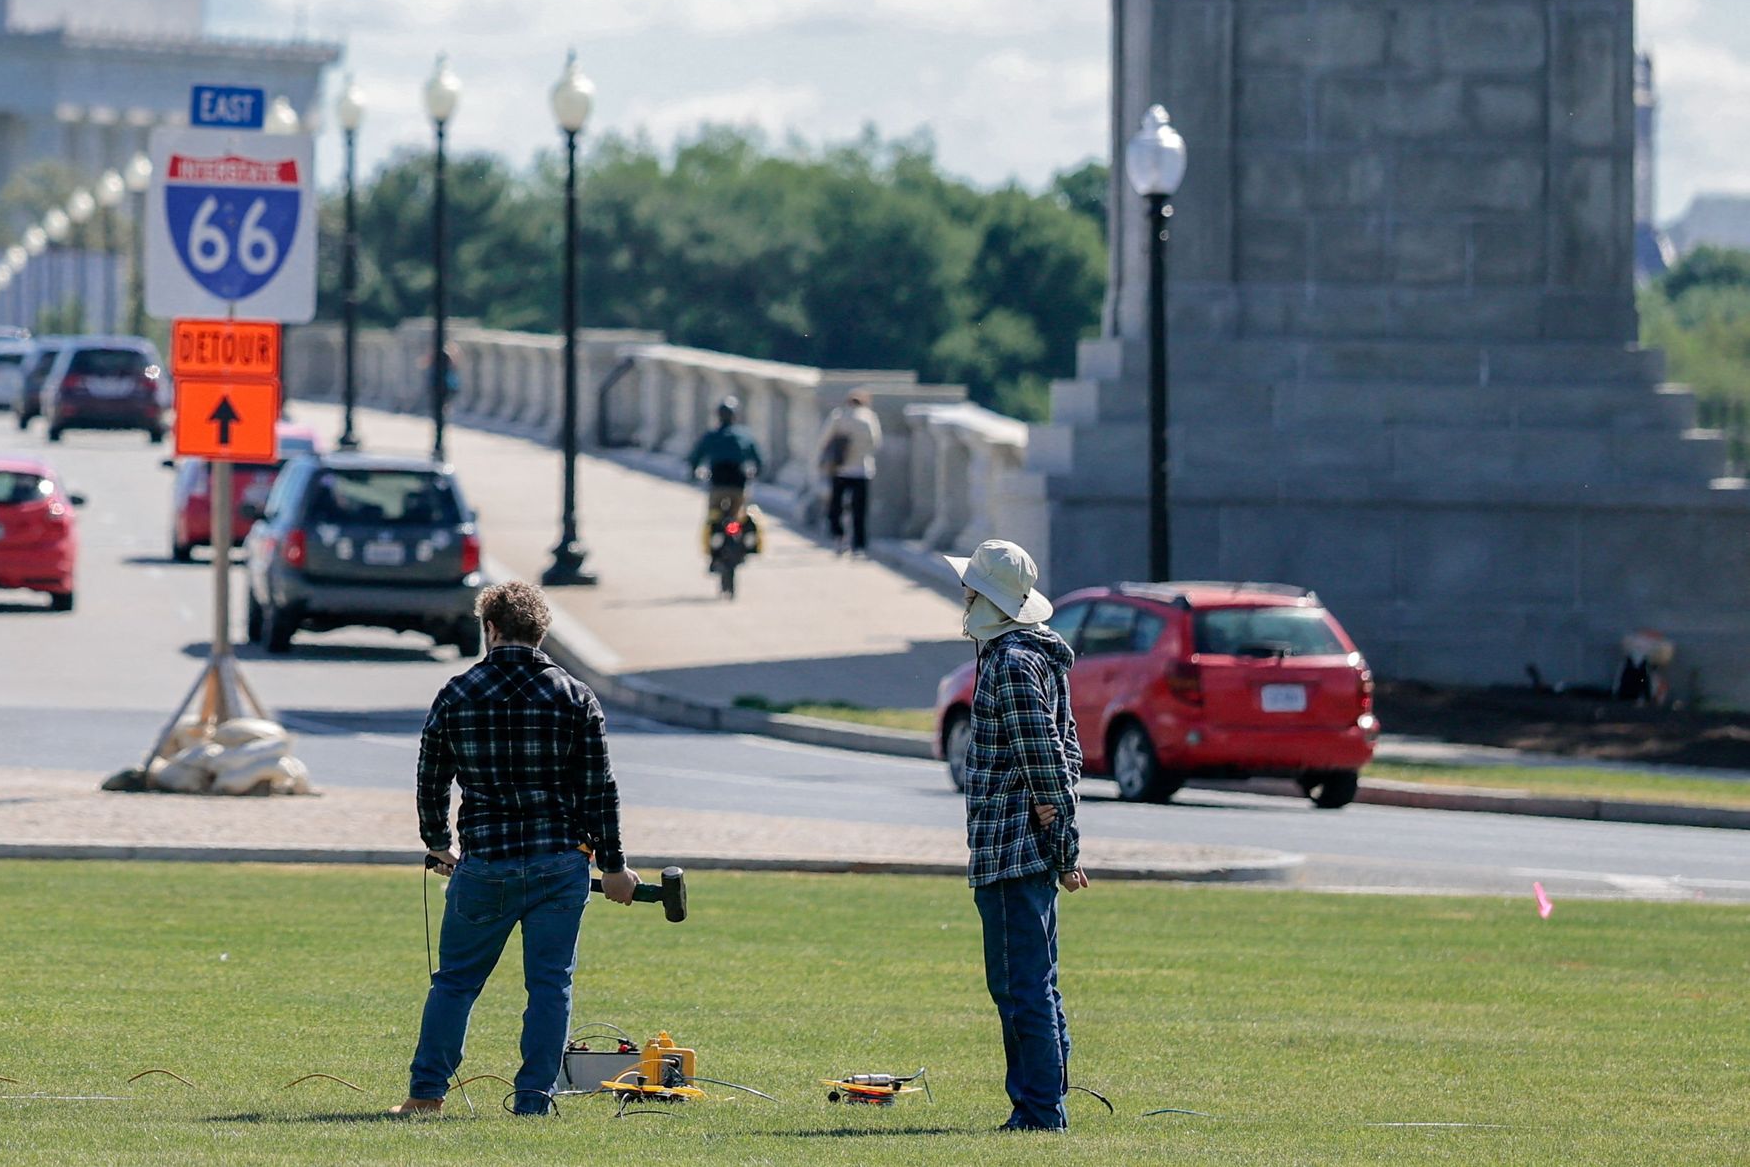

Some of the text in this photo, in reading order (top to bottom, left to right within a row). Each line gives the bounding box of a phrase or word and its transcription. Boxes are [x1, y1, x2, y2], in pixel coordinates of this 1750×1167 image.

[199, 90, 254, 123] EAST
[178, 159, 280, 184] INTERSTATE
[188, 194, 278, 275] 66
[180, 332, 272, 366] DETOUR
